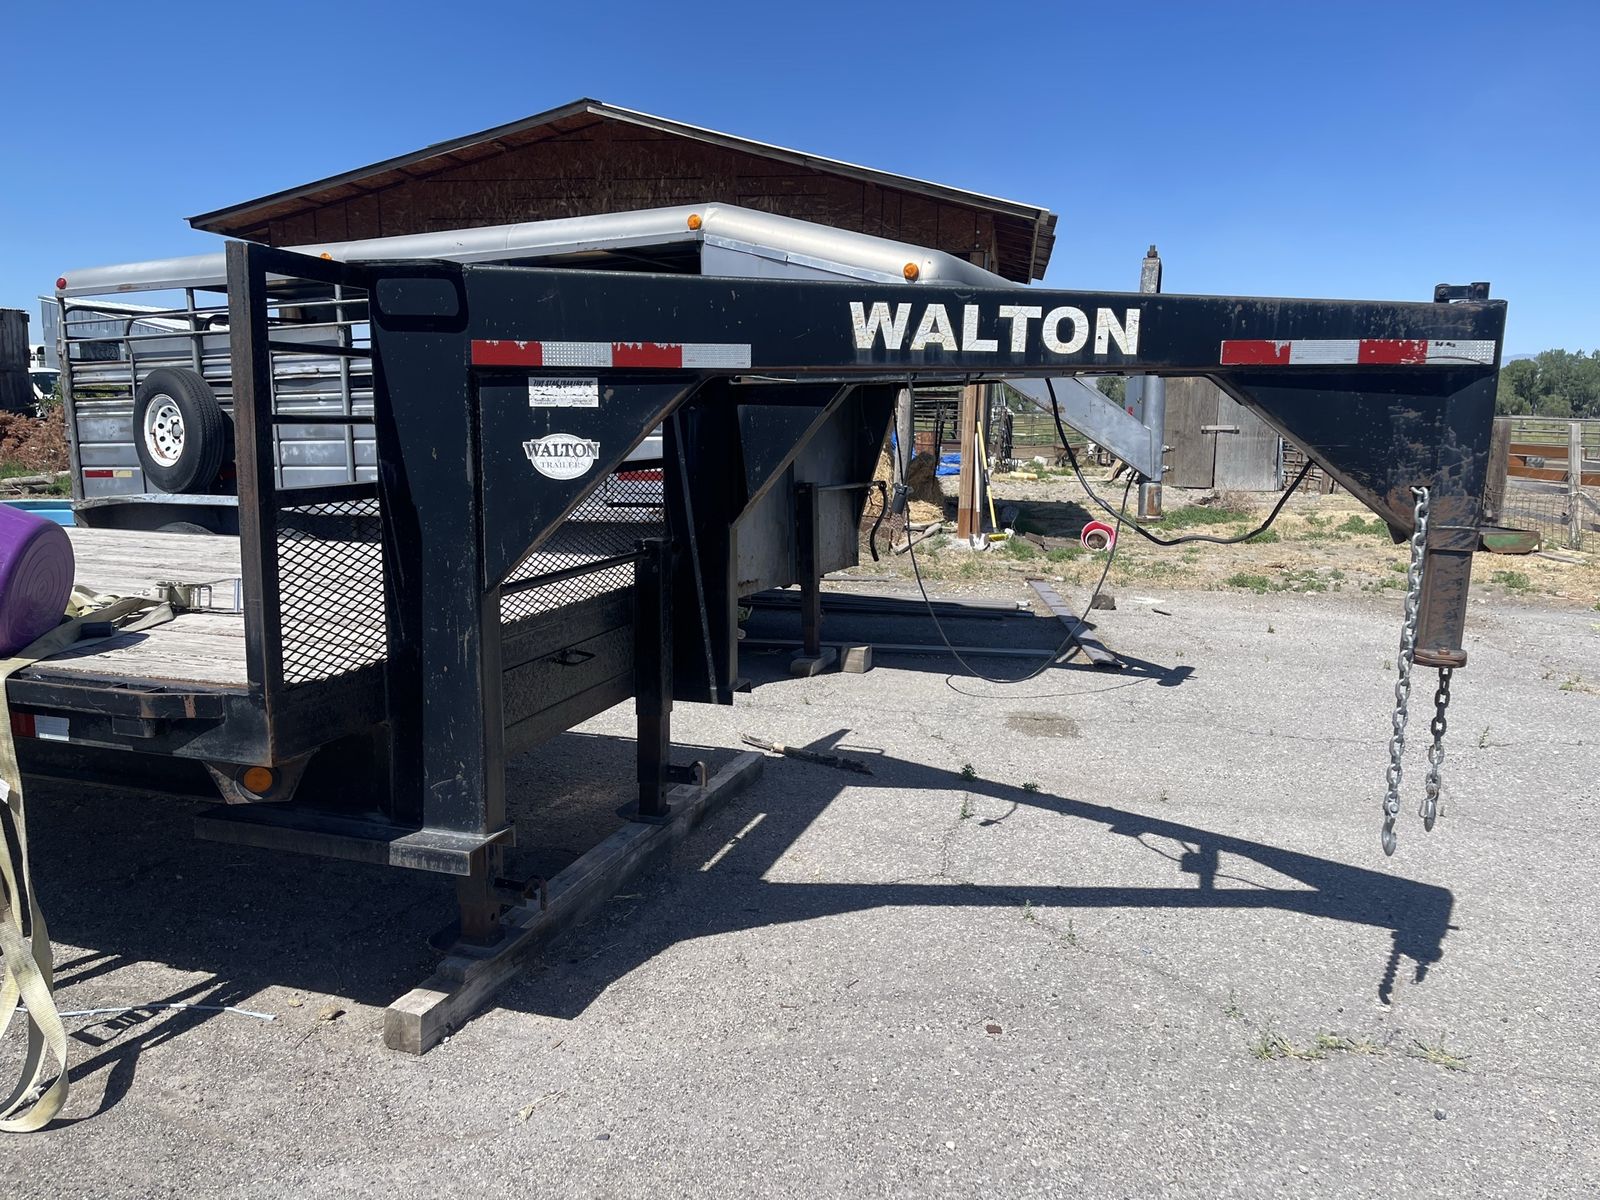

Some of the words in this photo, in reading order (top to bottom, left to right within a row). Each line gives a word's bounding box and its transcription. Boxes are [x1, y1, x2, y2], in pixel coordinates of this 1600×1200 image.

[849, 301, 1140, 355] WALTON
[523, 442, 599, 458] WALTON
[540, 461, 586, 469] TRAILERS
